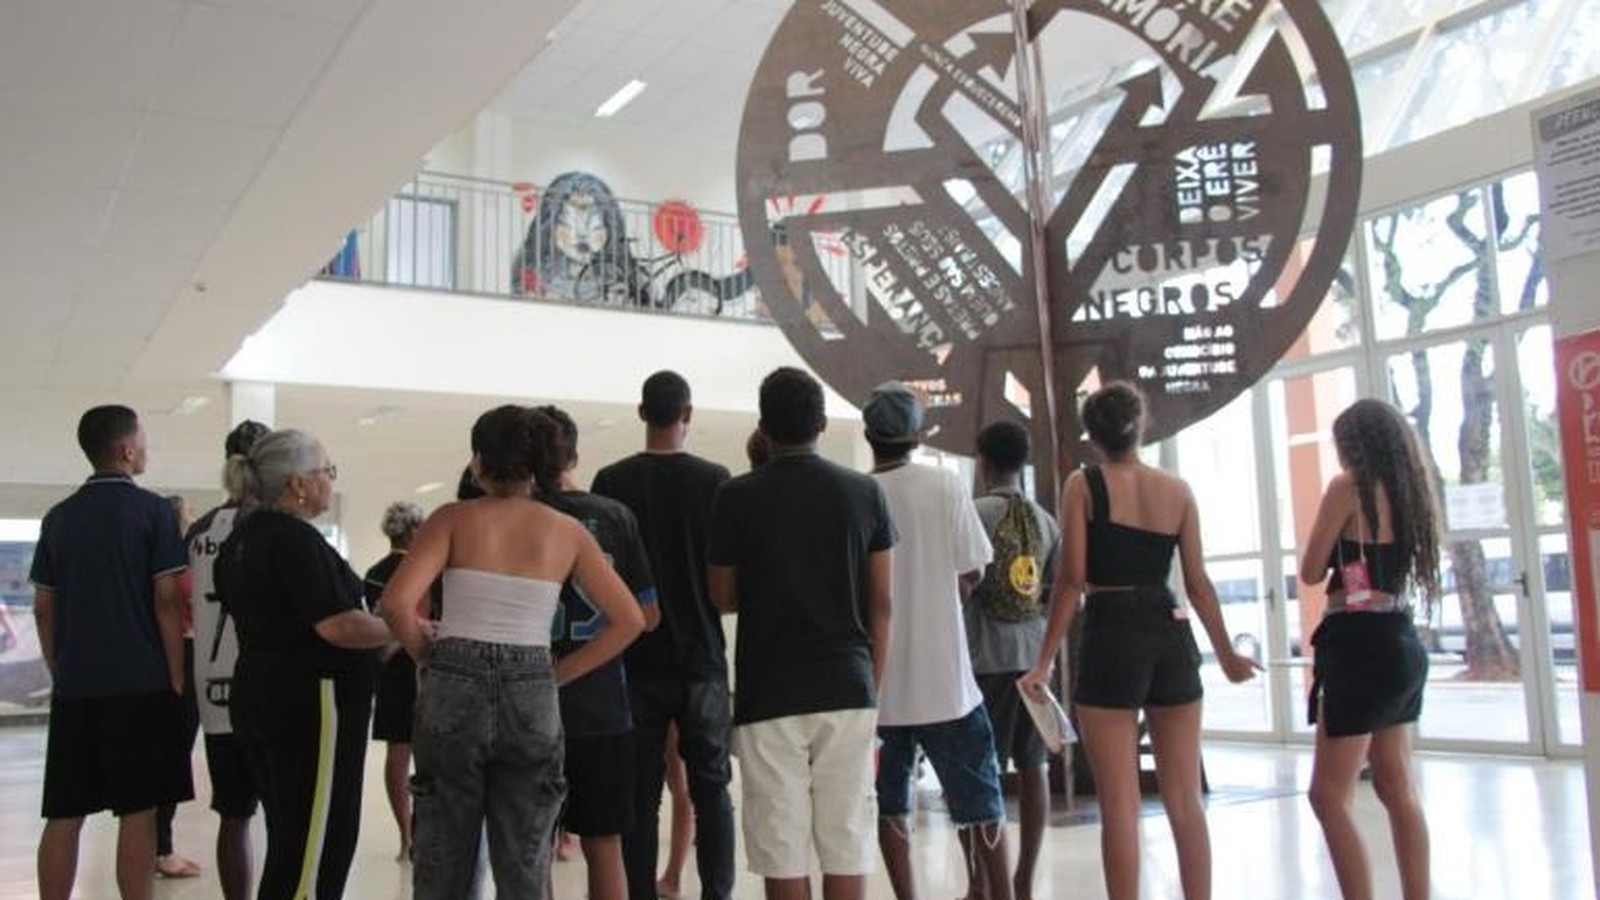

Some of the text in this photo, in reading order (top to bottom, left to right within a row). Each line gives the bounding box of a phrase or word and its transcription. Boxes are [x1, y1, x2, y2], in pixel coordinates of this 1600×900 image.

[820, 0, 899, 61] JUVENTUDE
[839, 31, 886, 77] NEGRA
[844, 55, 875, 89] VIVA
[786, 68, 827, 162] DOR
[1175, 146, 1202, 224] DEIXA
[1231, 142, 1260, 222] VIVER
[1208, 204, 1232, 222] O
[1111, 238, 1266, 276] CORPOS
[843, 227, 953, 365] ESPERANÇA
[1084, 282, 1235, 320] NEGROS
[1214, 324, 1234, 338] AO
